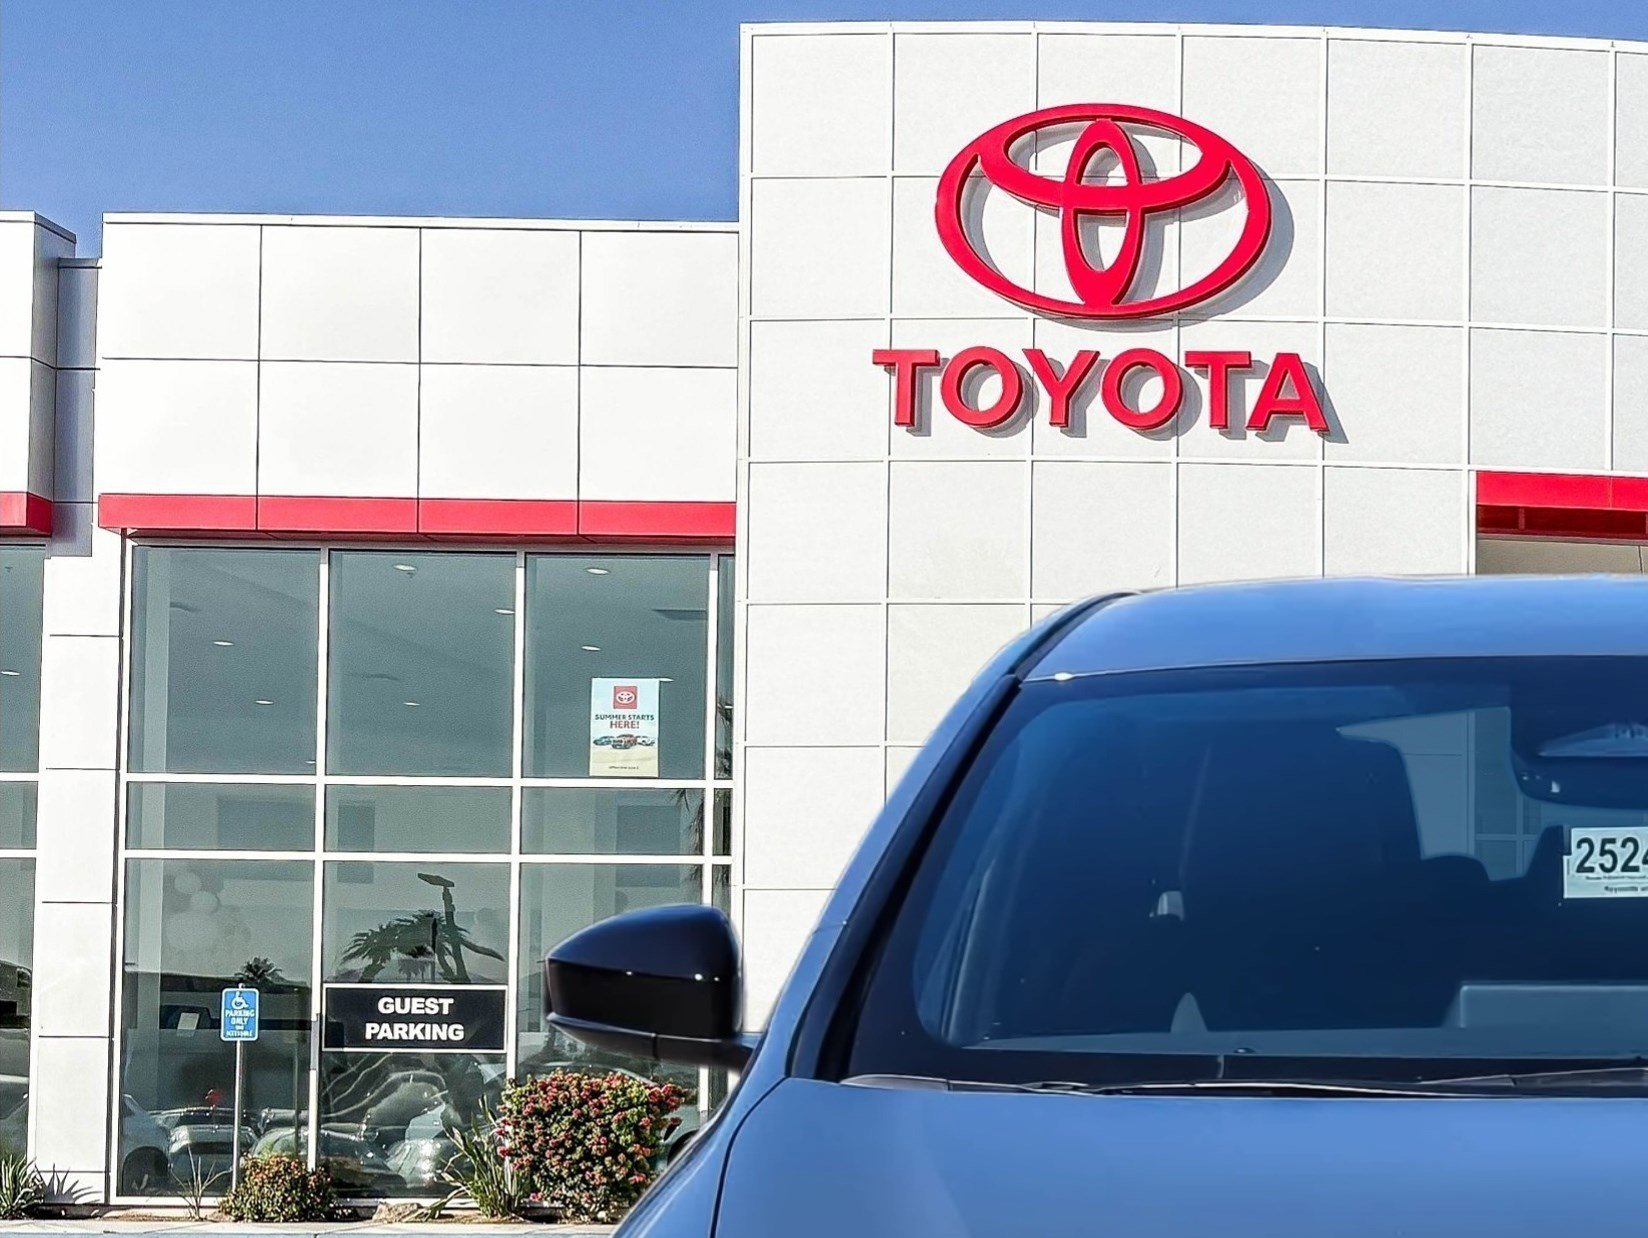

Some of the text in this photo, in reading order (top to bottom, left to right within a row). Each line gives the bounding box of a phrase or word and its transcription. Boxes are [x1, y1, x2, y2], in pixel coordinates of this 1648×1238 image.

[872, 346, 1330, 434] TOYOTA
[609, 720, 640, 729] HERE!
[377, 996, 454, 1015] GUEST
[365, 1022, 465, 1041] PARKING
